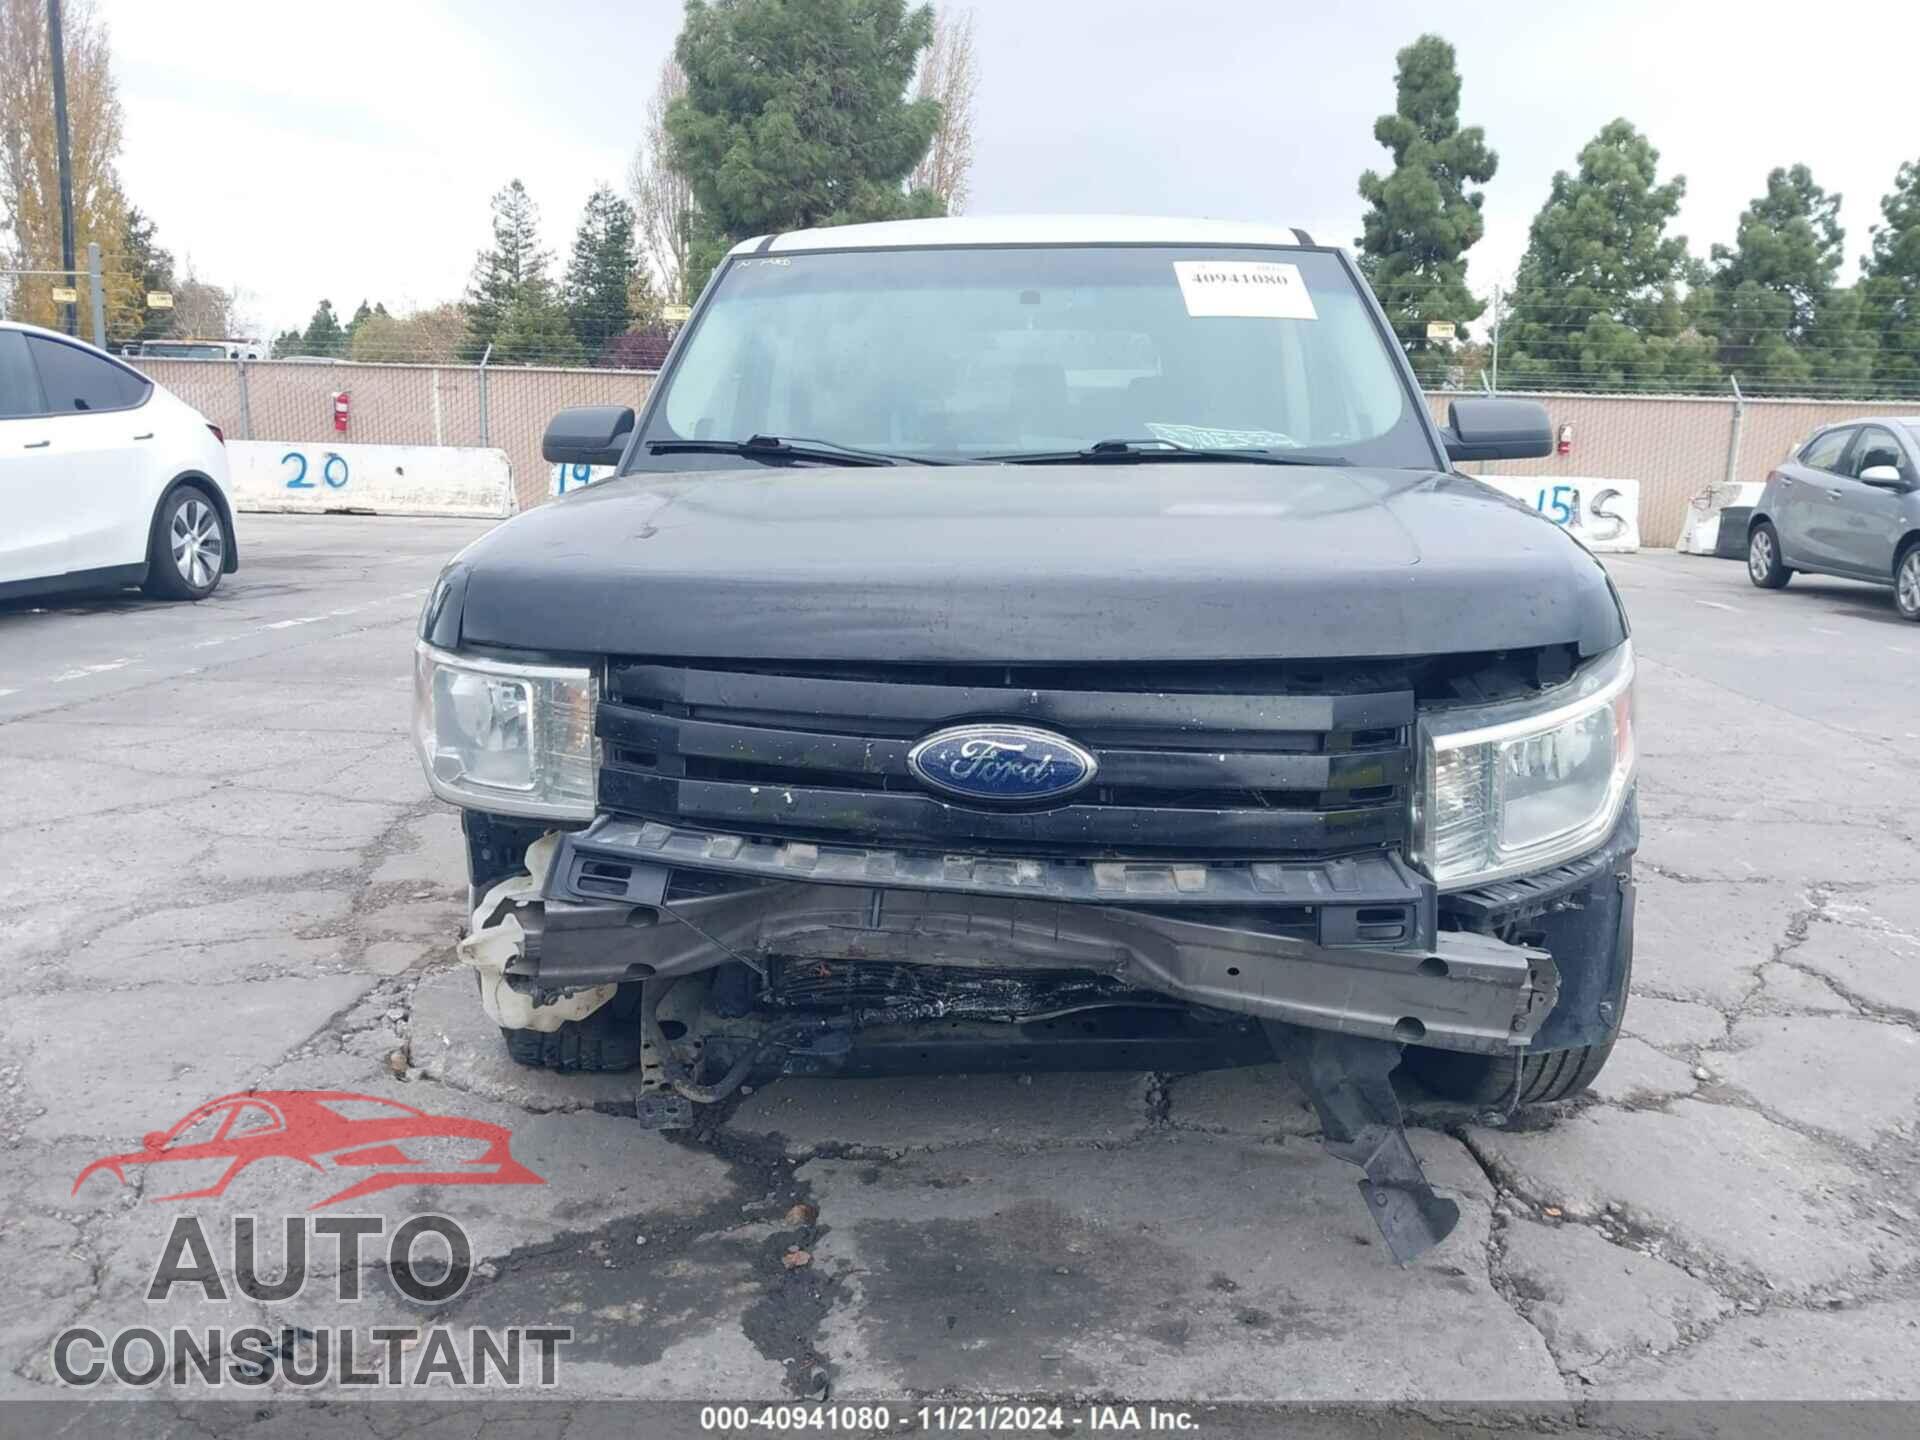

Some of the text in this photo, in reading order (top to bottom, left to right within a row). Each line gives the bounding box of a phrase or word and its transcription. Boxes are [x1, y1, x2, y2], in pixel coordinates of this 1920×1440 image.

[1191, 272, 1289, 286] 40941080
[281, 452, 349, 488] 20
[950, 739, 1055, 784] Ford
